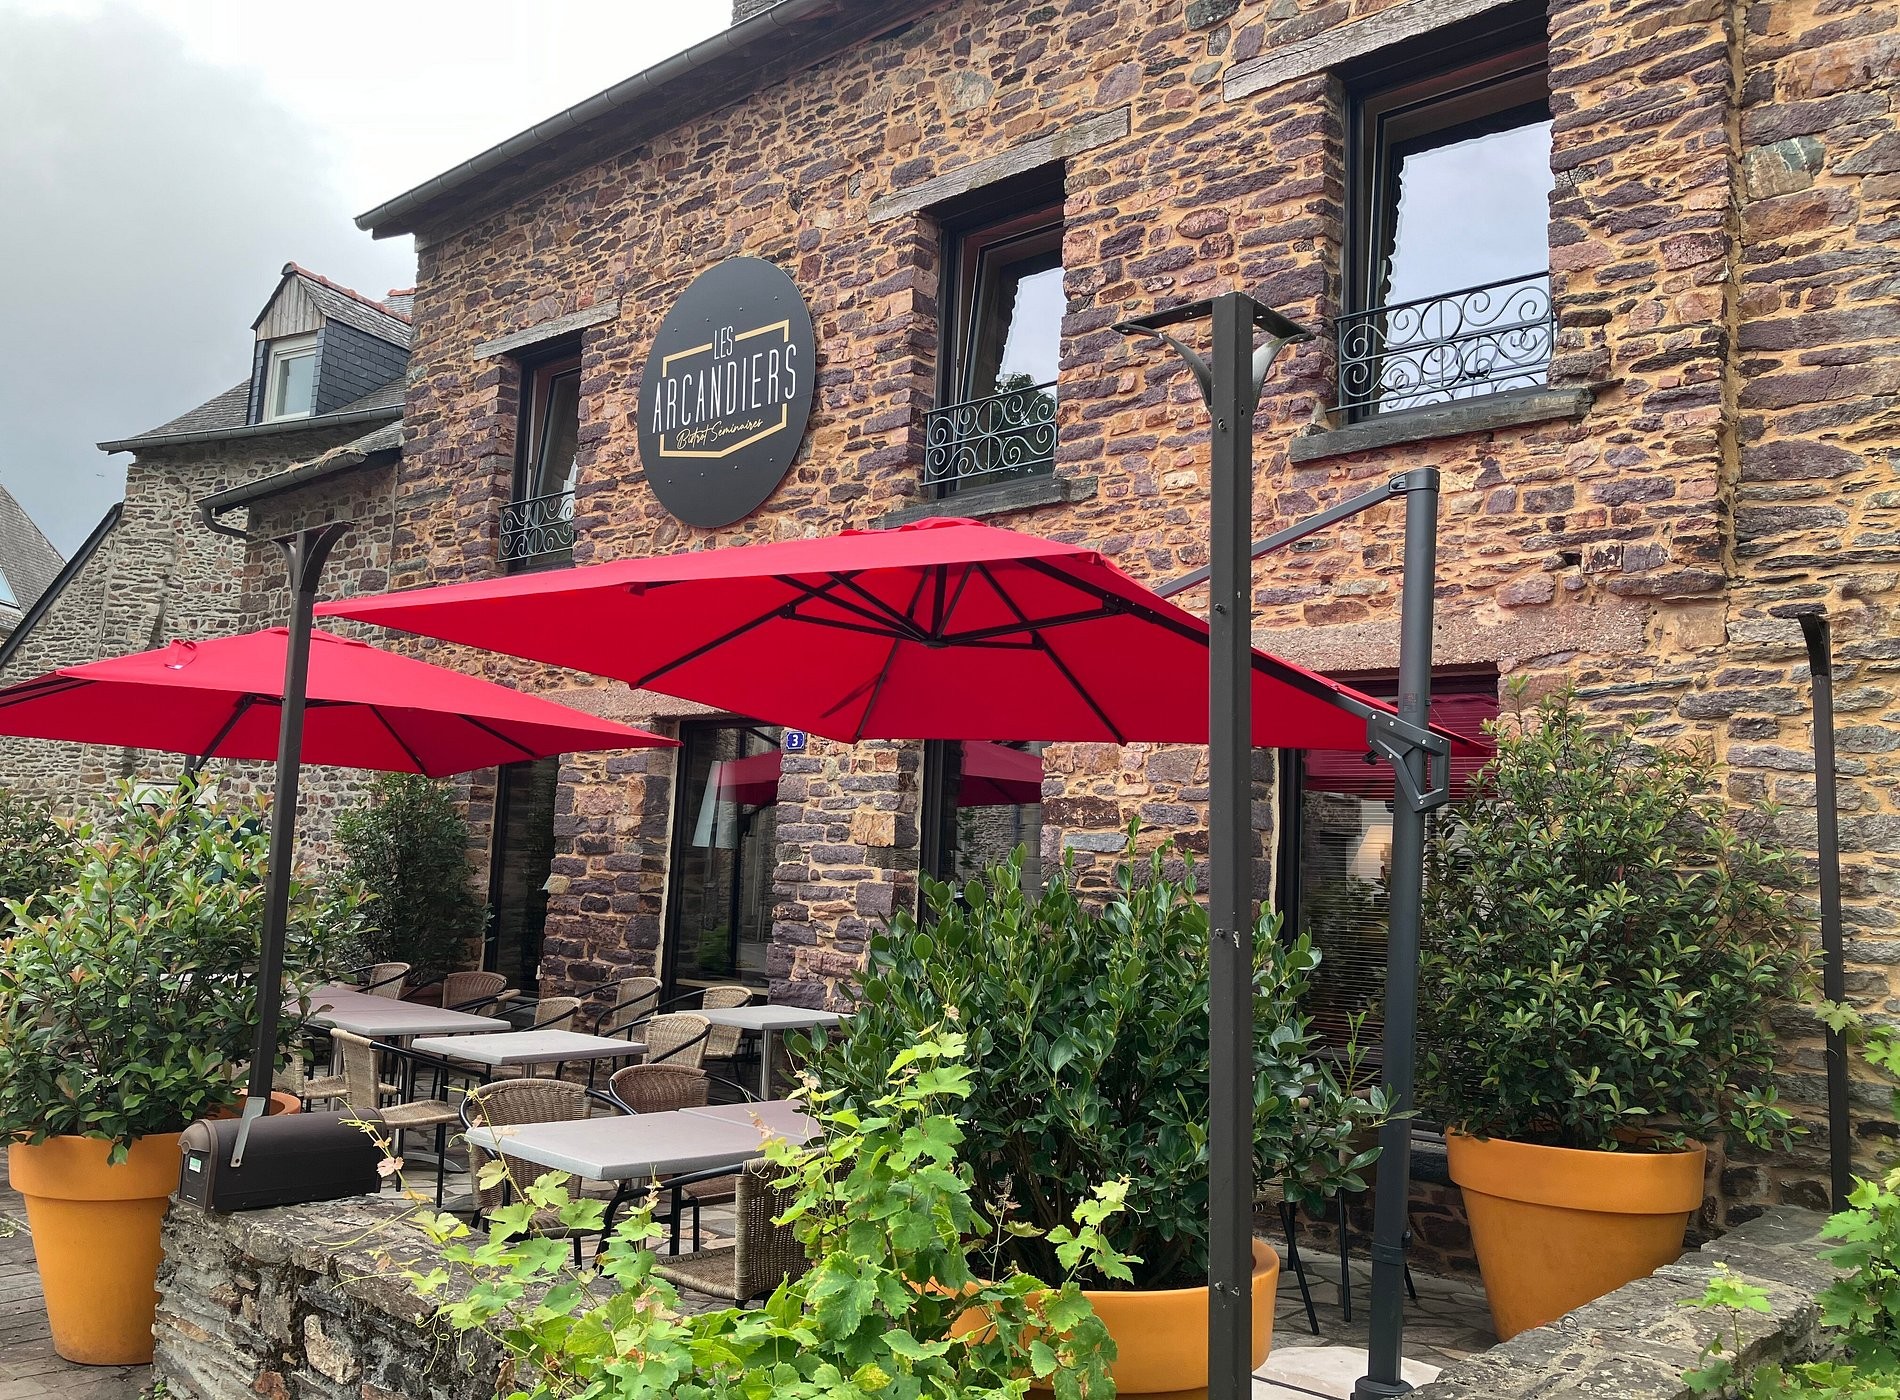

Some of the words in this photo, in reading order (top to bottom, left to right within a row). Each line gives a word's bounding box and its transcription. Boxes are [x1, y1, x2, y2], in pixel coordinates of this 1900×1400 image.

[714, 325, 734, 360] LES
[652, 343, 797, 434] ARCANDIERS
[676, 424, 710, 450] Bistrot
[791, 734, 799, 747] 3
